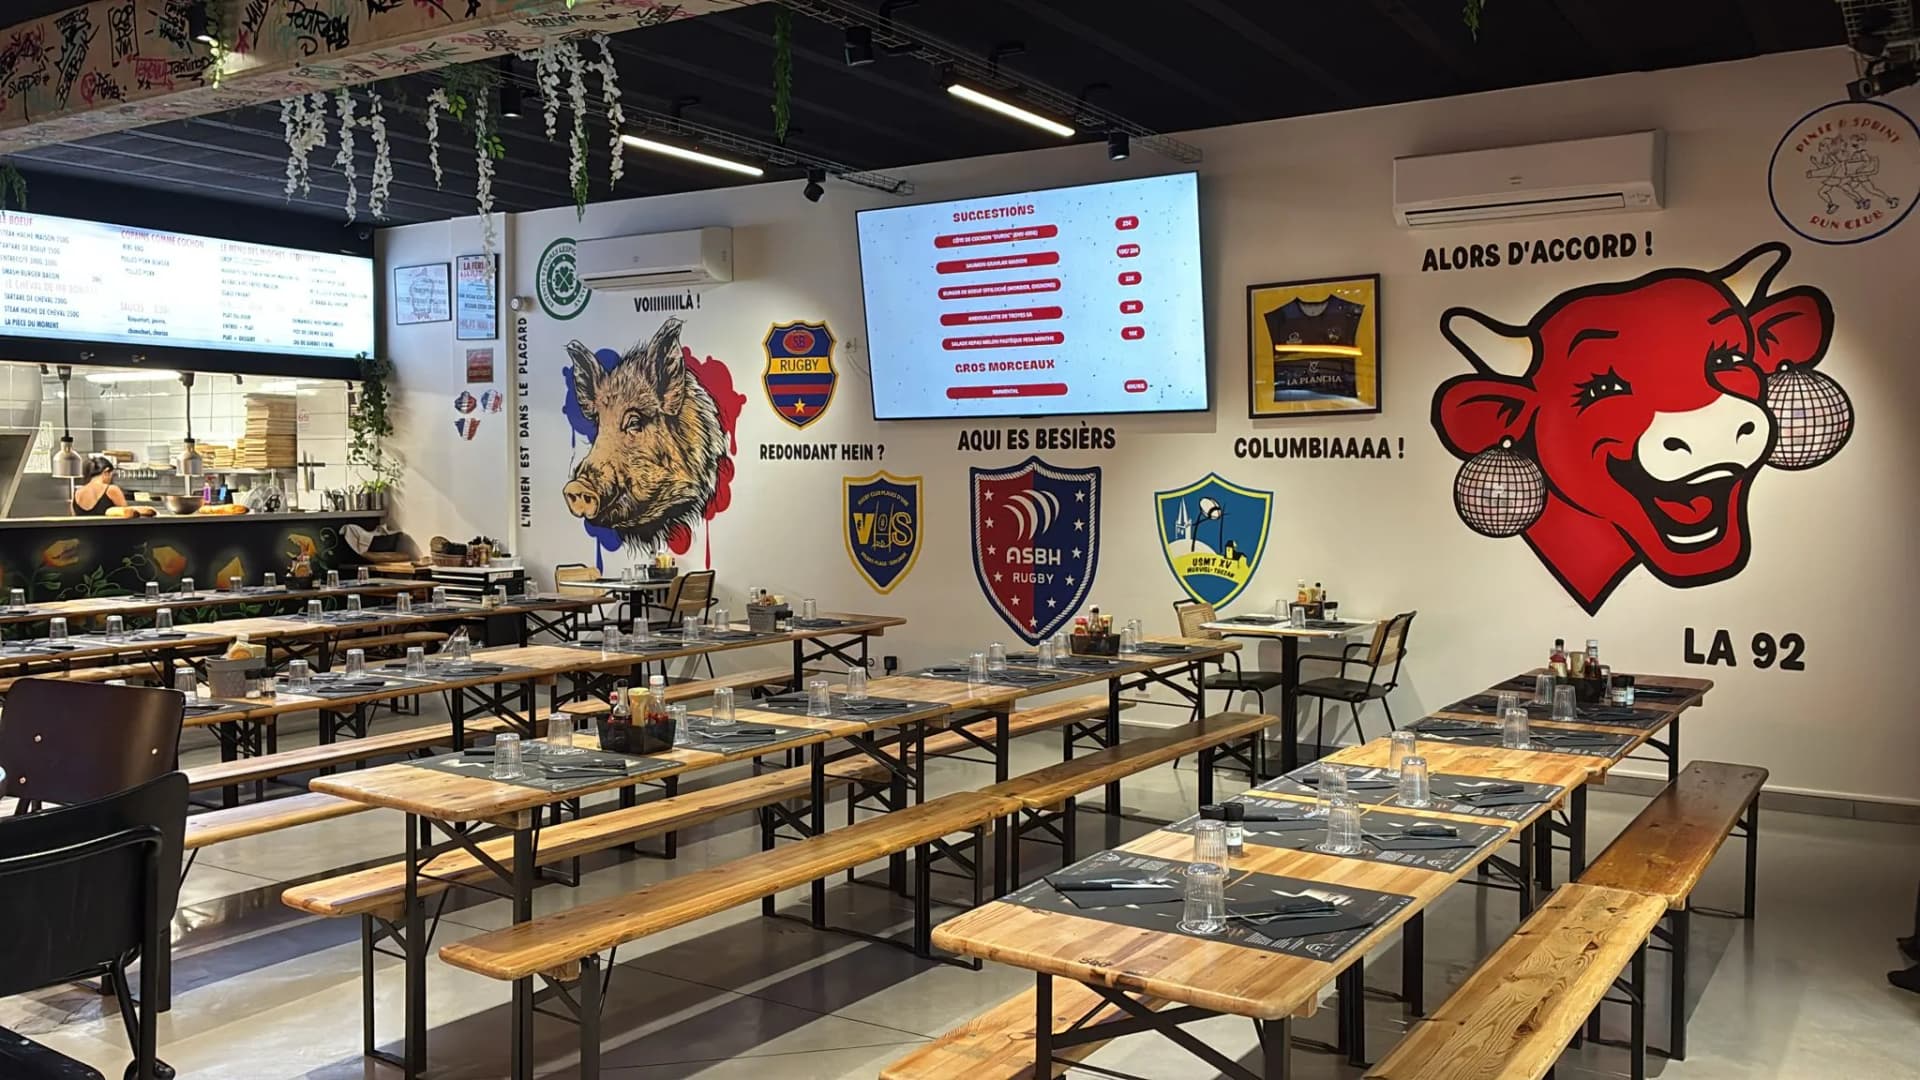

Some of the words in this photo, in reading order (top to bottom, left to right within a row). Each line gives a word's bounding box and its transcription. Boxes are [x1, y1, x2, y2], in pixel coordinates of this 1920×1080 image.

[1810, 215, 1840, 229] RUN
[1844, 210, 1884, 229] CLUB
[1422, 244, 1501, 271] ALORS
[1508, 233, 1637, 265] D'ACCORD
[1645, 231, 1653, 256] !
[697, 293, 701, 309] !
[4, 317, 12, 326] LA
[27, 320, 36, 328] DU
[36, 320, 59, 329] MOMENT
[518, 317, 529, 374] PLACARD
[780, 359, 820, 373] RUGBY
[988, 359, 1055, 372] MORCEAUX
[519, 383, 529, 396] LE
[1299, 375, 1343, 385] PLANCHA
[519, 405, 530, 437] DANS
[957, 430, 1001, 451] AQUI
[1007, 429, 1029, 450] ES
[1035, 421, 1116, 450] BESIÈRS
[520, 447, 530, 467] EST
[760, 444, 838, 460] REDONDANT
[841, 444, 873, 460] HEIN
[877, 444, 885, 461] ?
[1234, 437, 1391, 459] COLUMBIAAAA
[1398, 437, 1405, 459] !
[520, 477, 531, 527] L'INDIEN
[1006, 546, 1061, 566] ASBH
[1192, 557, 1217, 568] USMT
[1219, 558, 1233, 569] XV
[1012, 572, 1055, 584] RUGBY
[1683, 627, 1737, 667] LA
[1751, 632, 1805, 672] 92
